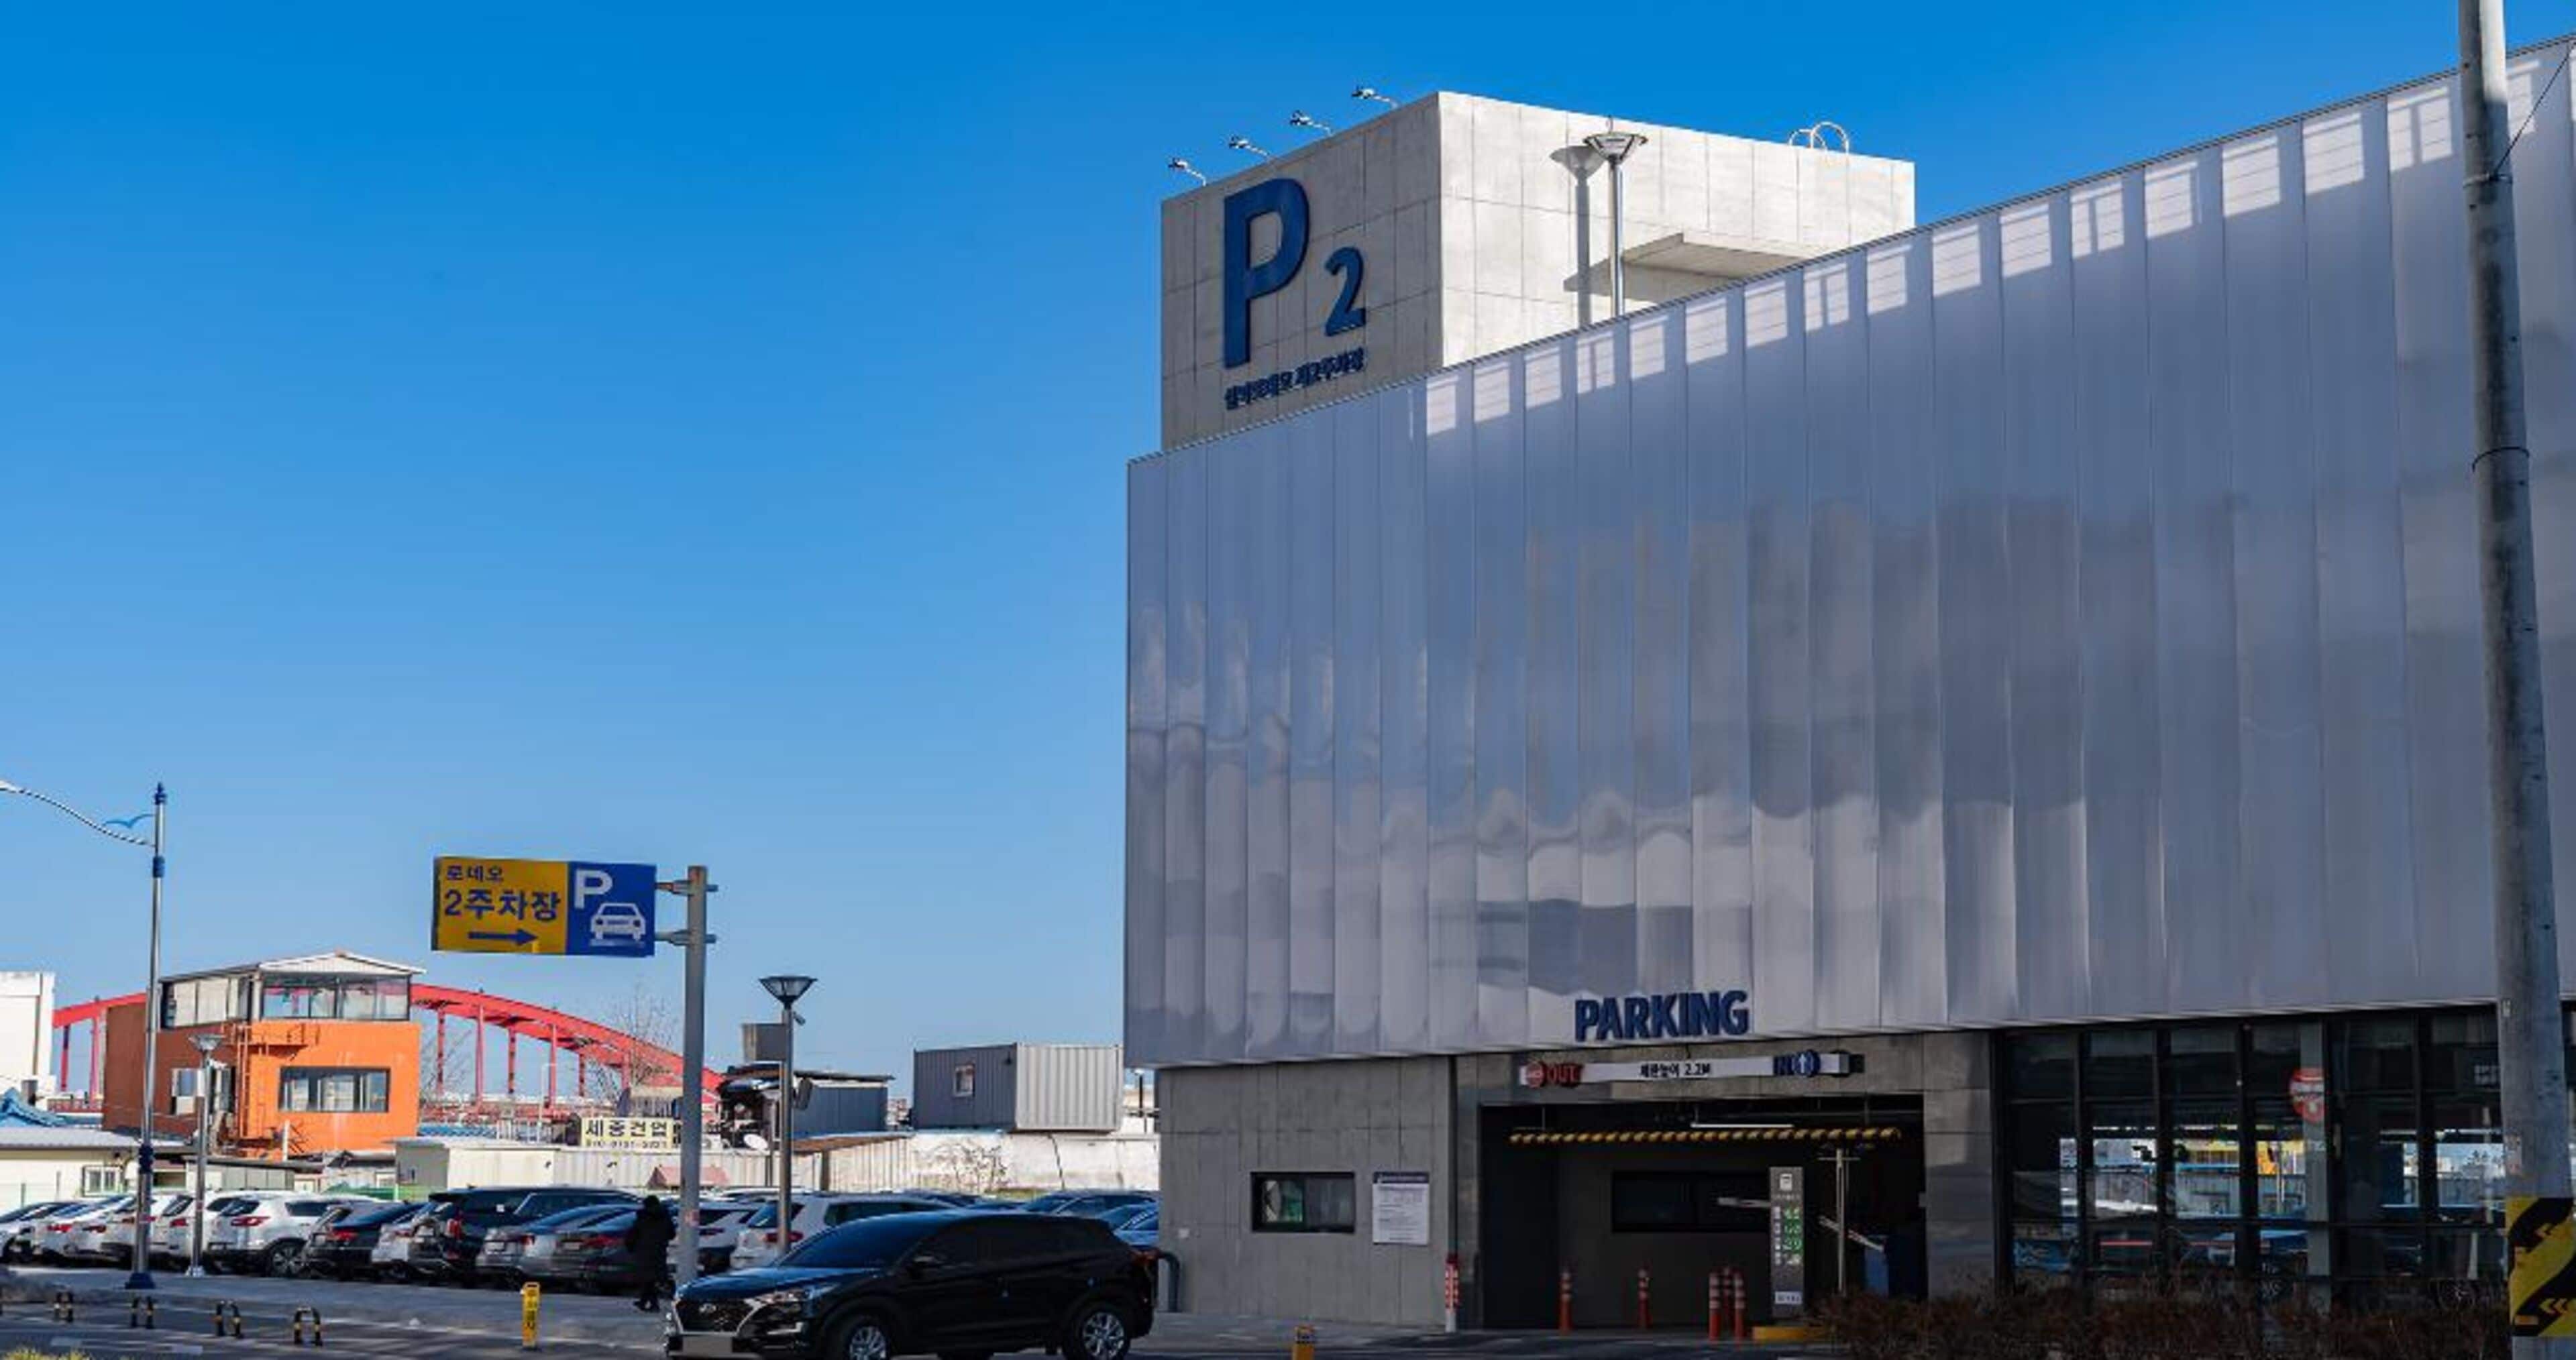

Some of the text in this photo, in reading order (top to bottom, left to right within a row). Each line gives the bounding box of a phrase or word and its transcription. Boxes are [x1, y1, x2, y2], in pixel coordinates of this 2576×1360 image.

[1224, 178, 1366, 369] P 2
[446, 865, 504, 883] 로데오
[574, 870, 613, 909] P
[444, 889, 561, 922] 2주차장
[1575, 990, 1749, 1042] PARKING
[1546, 1062, 1582, 1086] OUT
